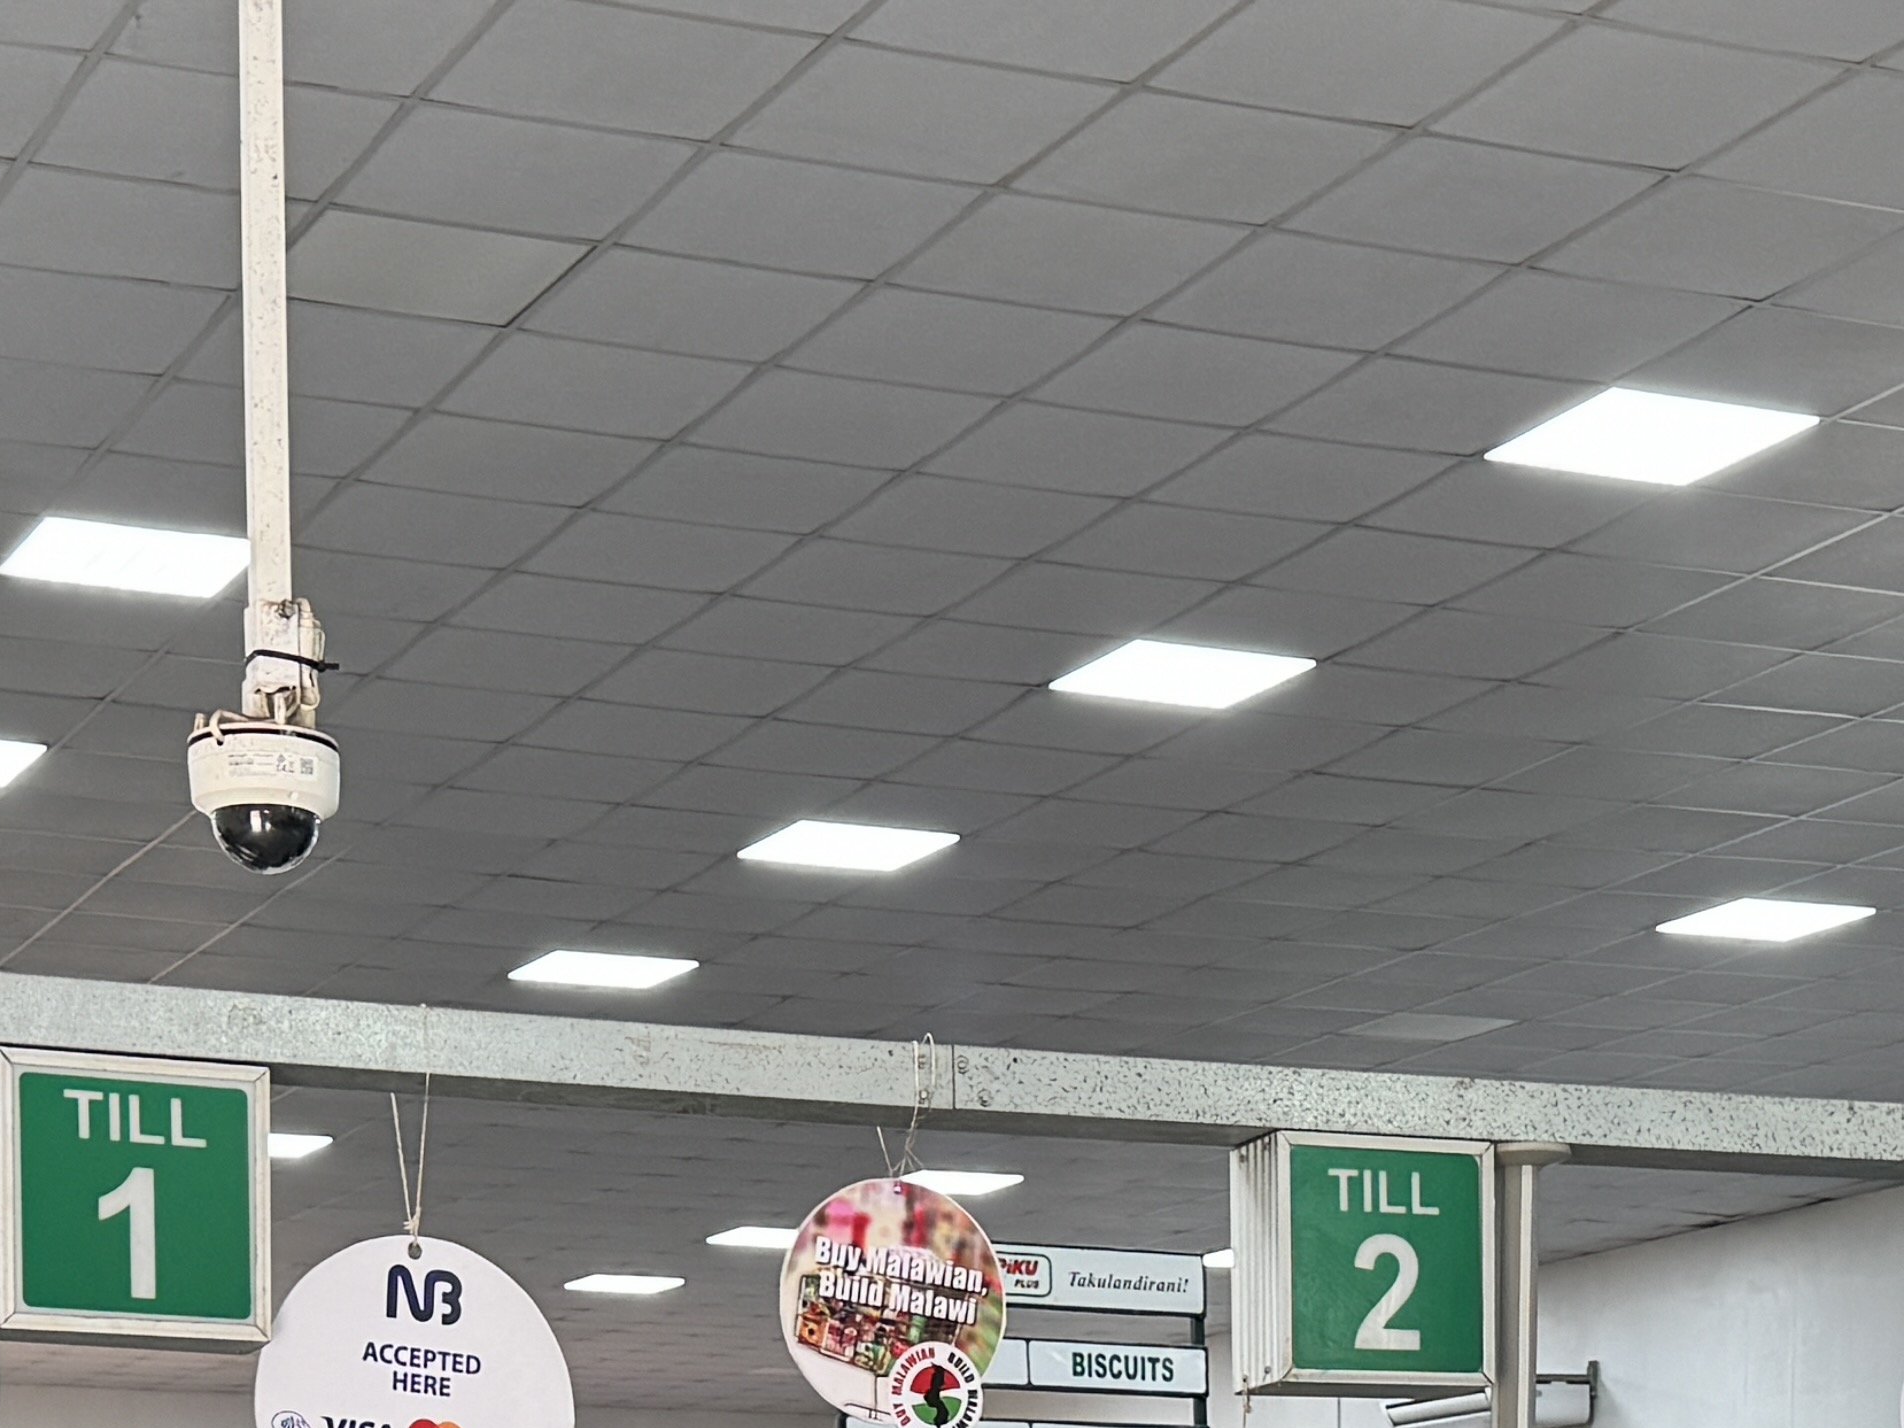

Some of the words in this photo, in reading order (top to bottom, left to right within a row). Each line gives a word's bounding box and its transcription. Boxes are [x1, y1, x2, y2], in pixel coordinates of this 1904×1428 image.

[64, 1089, 207, 1148] TILL
[1328, 1168, 1439, 1215] TILL
[98, 1167, 155, 1299] 1
[816, 1236, 861, 1272] Buy
[866, 1246, 988, 1296] Malawian,
[1068, 1271, 1188, 1293] Takulandirani!
[819, 1271, 884, 1307] Build
[889, 1285, 977, 1324] Malawi
[1354, 1234, 1421, 1351] 2
[362, 1341, 481, 1376] ACCEPTED
[947, 1352, 975, 1385] BUILD
[1072, 1352, 1174, 1382] BISCUITS
[392, 1371, 451, 1398] HERE
